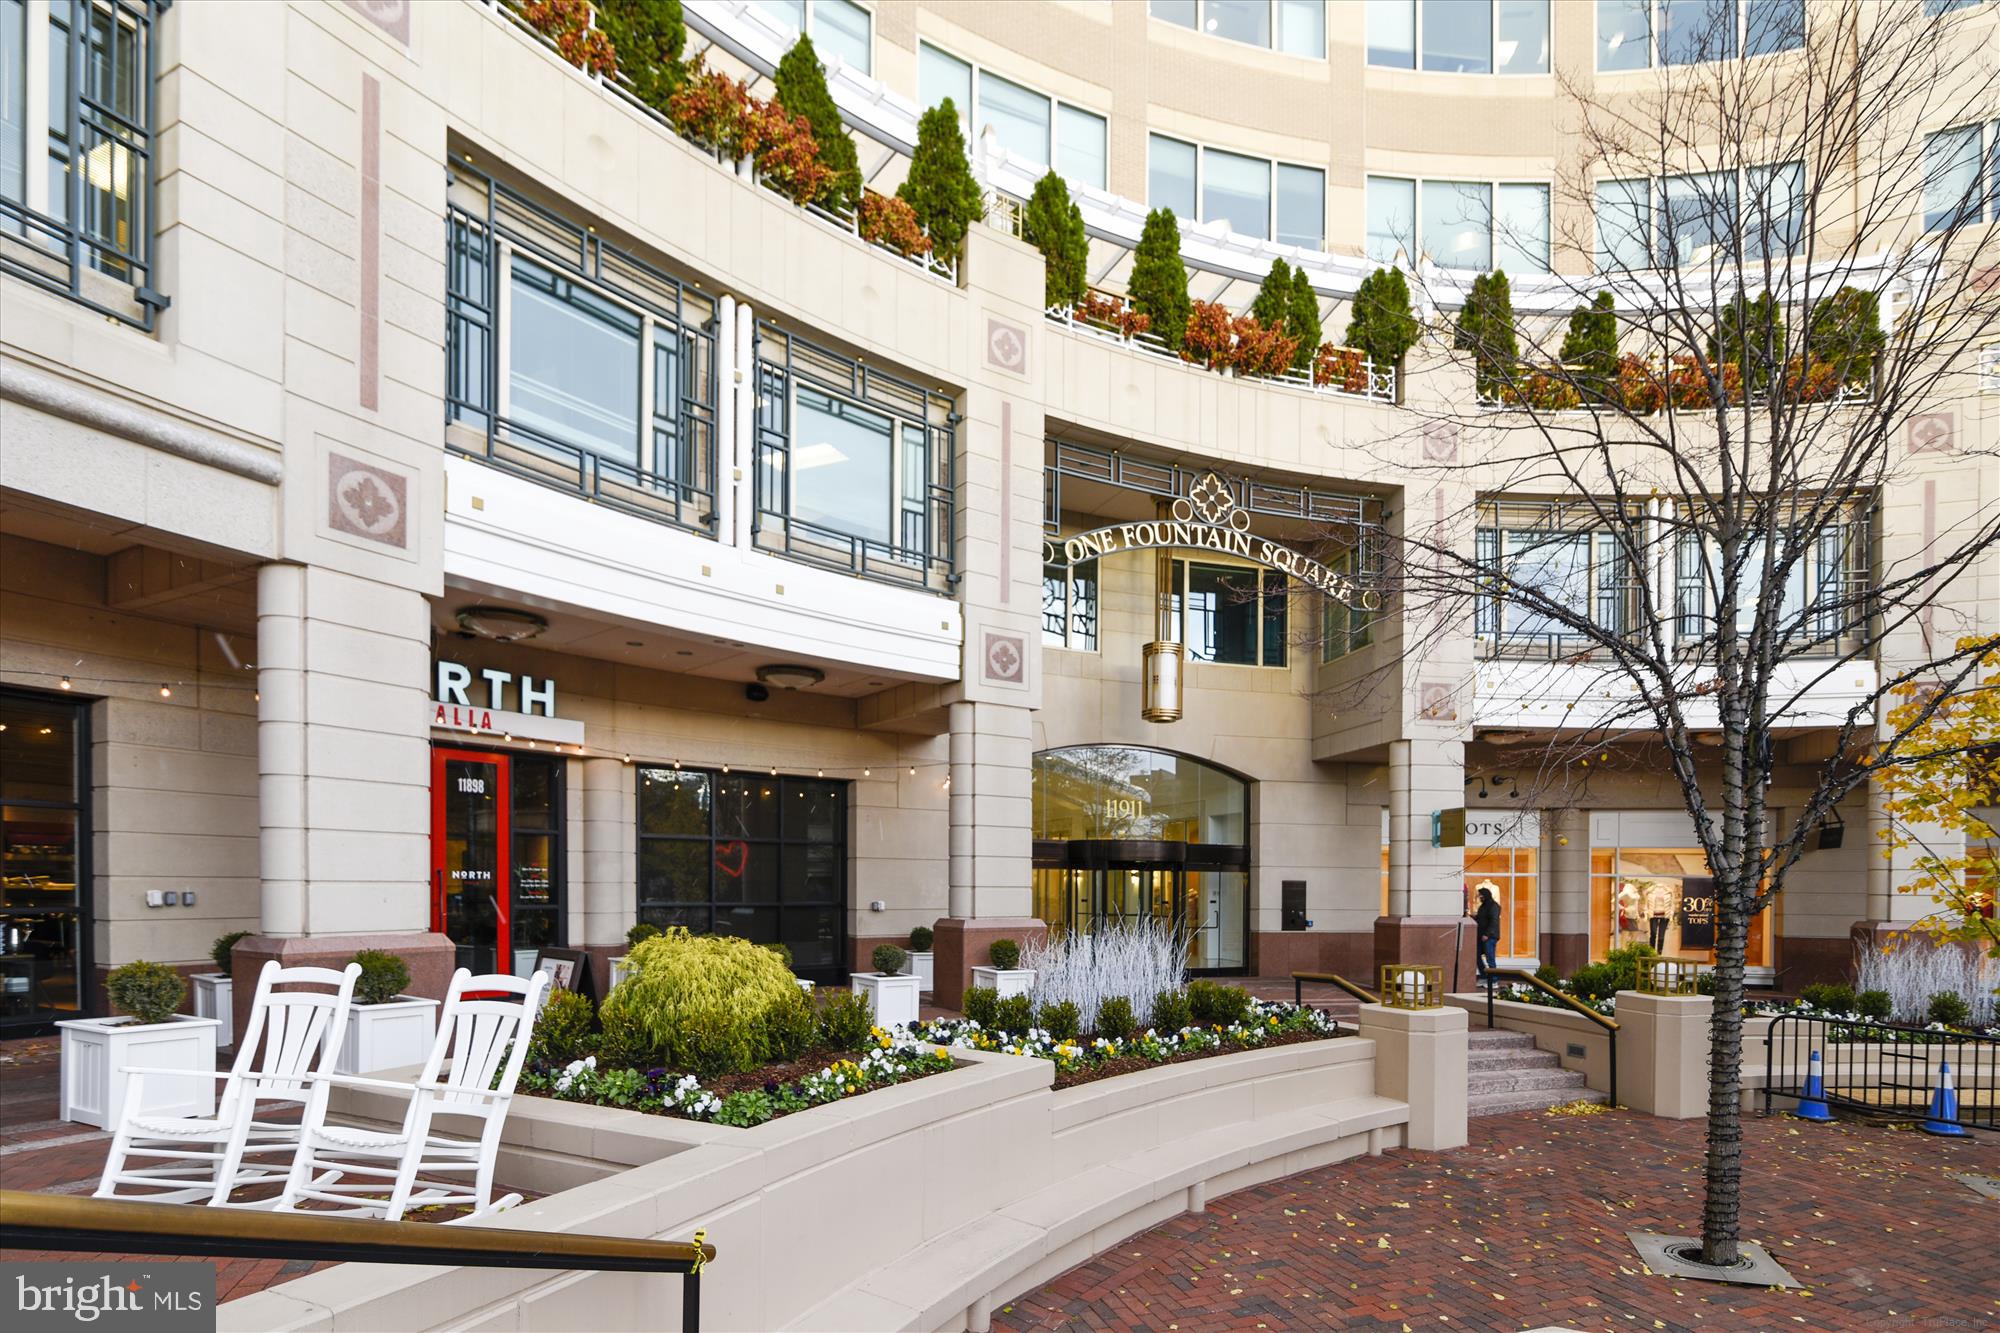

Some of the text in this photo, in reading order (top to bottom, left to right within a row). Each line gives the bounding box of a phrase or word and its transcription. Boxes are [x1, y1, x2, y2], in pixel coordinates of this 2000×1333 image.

[1064, 522, 1354, 602] ONE FOUNTAIN SQUARE
[457, 778, 485, 794] 11898
[1104, 799, 1143, 819] 11911
[452, 870, 491, 880] NORTH
[1688, 917, 1709, 925] TOPS
